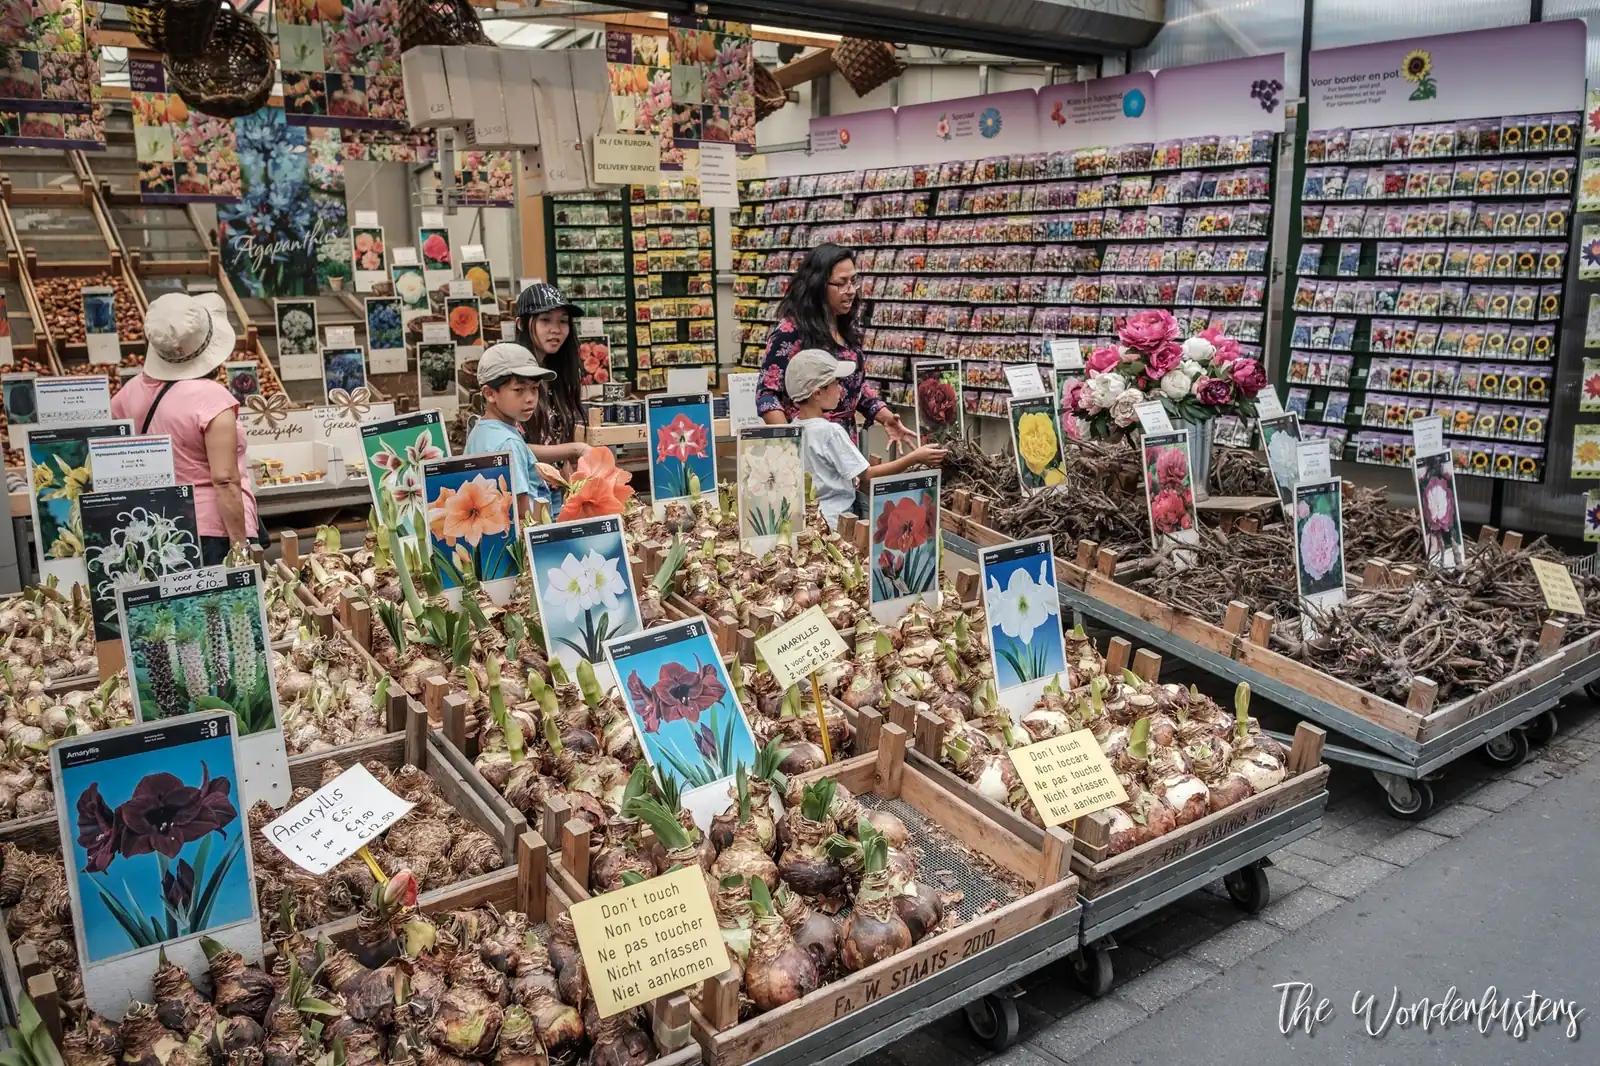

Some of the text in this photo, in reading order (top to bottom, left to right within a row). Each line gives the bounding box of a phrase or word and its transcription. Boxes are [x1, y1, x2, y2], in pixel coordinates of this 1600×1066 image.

[1311, 78, 1332, 87] Voor
[1334, 74, 1366, 85] border
[1382, 70, 1399, 81] pot
[598, 163, 656, 172] DELIVERY SERVICE
[172, 574, 192, 582] voor
[162, 587, 169, 596] 3
[174, 585, 192, 593] voor
[612, 645, 631, 653] Amaryllis
[777, 625, 820, 656] AMARYLLIS
[784, 663, 790, 671] 1
[790, 655, 805, 668] voor
[806, 650, 813, 658] €
[789, 672, 796, 680] 2
[797, 663, 811, 676] voor
[812, 658, 818, 666] €
[66, 746, 99, 759] Amaryllis
[1029, 740, 1081, 762] Don't touch
[1035, 752, 1089, 775] Non toccare
[1033, 763, 1102, 792] Ne pas toucher
[1043, 777, 1109, 804] Nicht anfassen
[272, 788, 344, 843] Amaryllis
[1050, 789, 1117, 818] Niet aankomen
[295, 844, 303, 852] 1
[310, 827, 323, 841] for
[306, 854, 316, 862] 2
[323, 838, 335, 849] for
[320, 861, 328, 869] 3
[337, 847, 348, 857] for
[601, 883, 680, 919] Don't touch
[604, 902, 687, 939] Non toccare
[597, 917, 704, 964] Ne pas toucher
[607, 936, 708, 983] Nicht anfassen
[864, 979, 882, 1003] W.
[890, 949, 949, 991] STAATS
[961, 928, 996, 959] 2010
[612, 955, 714, 1003] Niet aankomen
